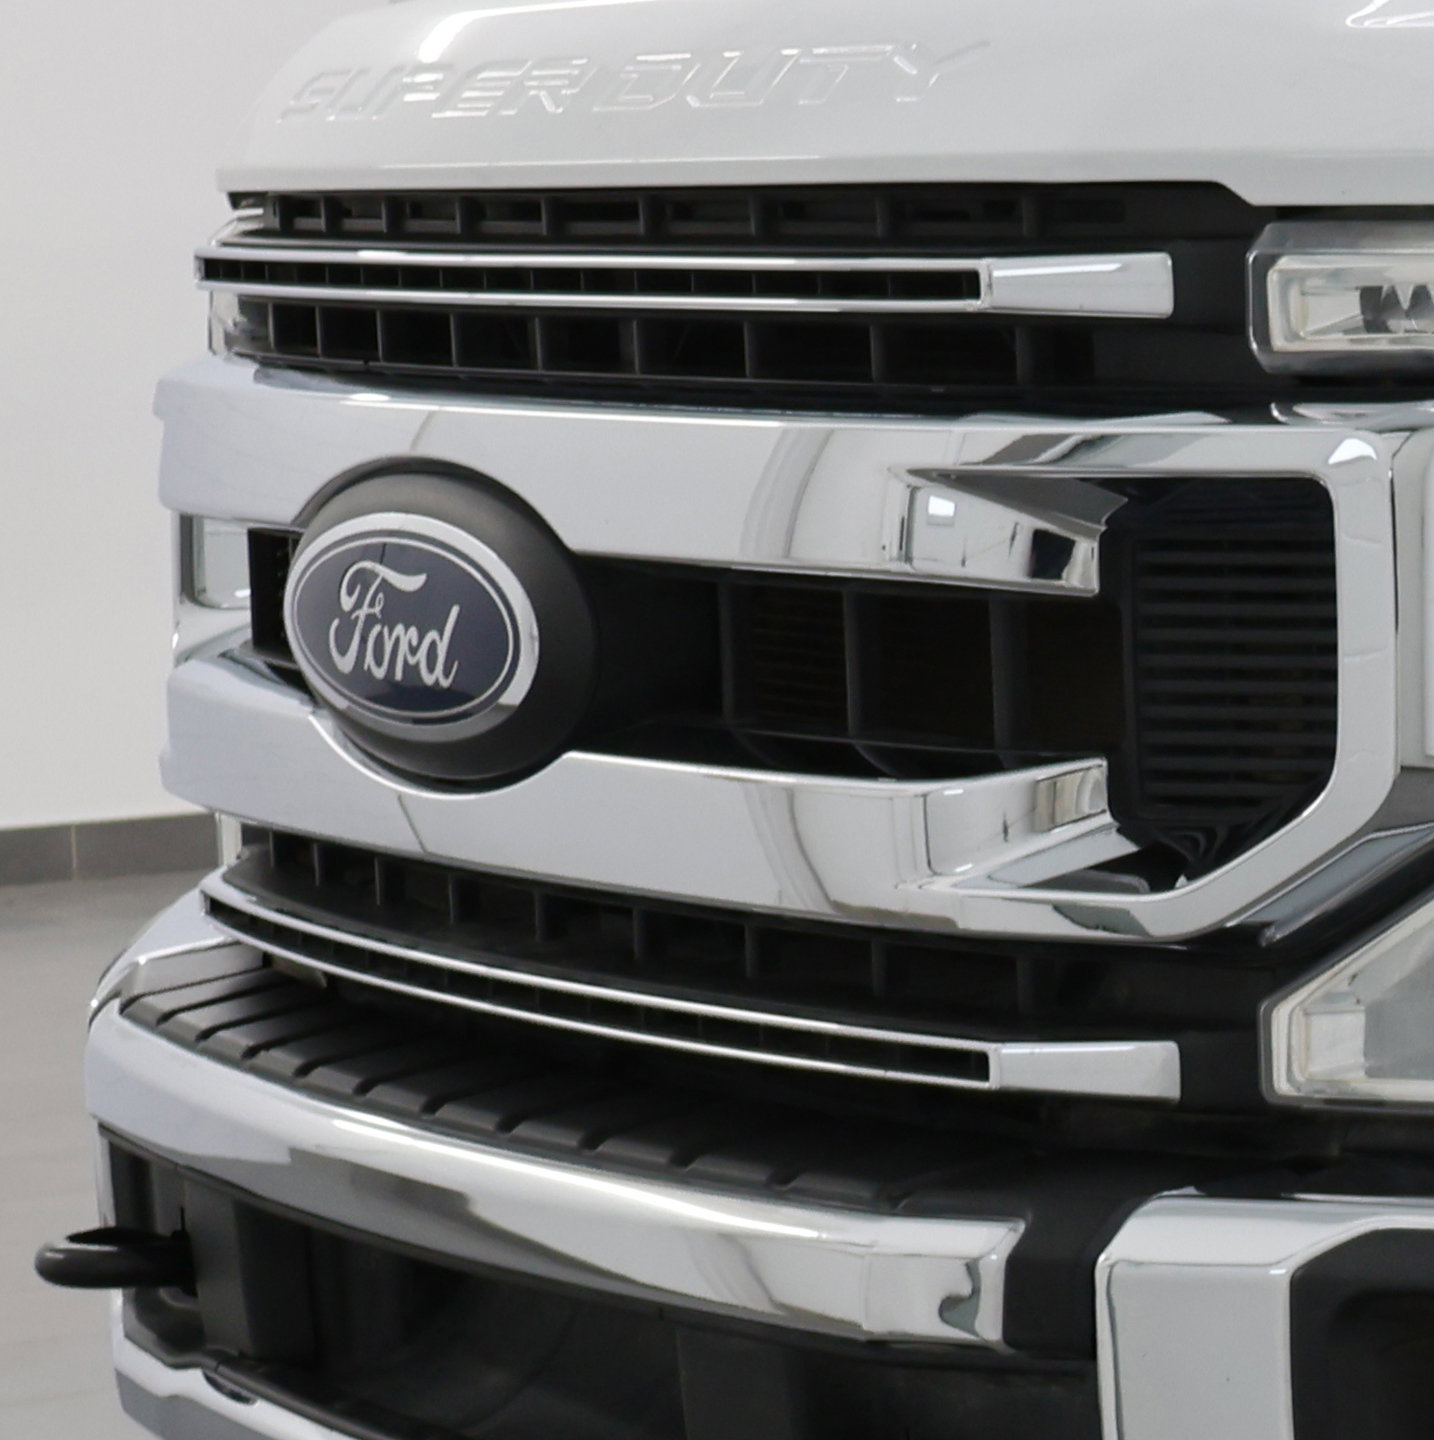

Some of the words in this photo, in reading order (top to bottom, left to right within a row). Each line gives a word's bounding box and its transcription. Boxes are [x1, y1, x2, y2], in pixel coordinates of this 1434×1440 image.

[276, 58, 592, 122] SUPER
[592, 41, 988, 112] DUTY
[329, 560, 460, 689] Ford
